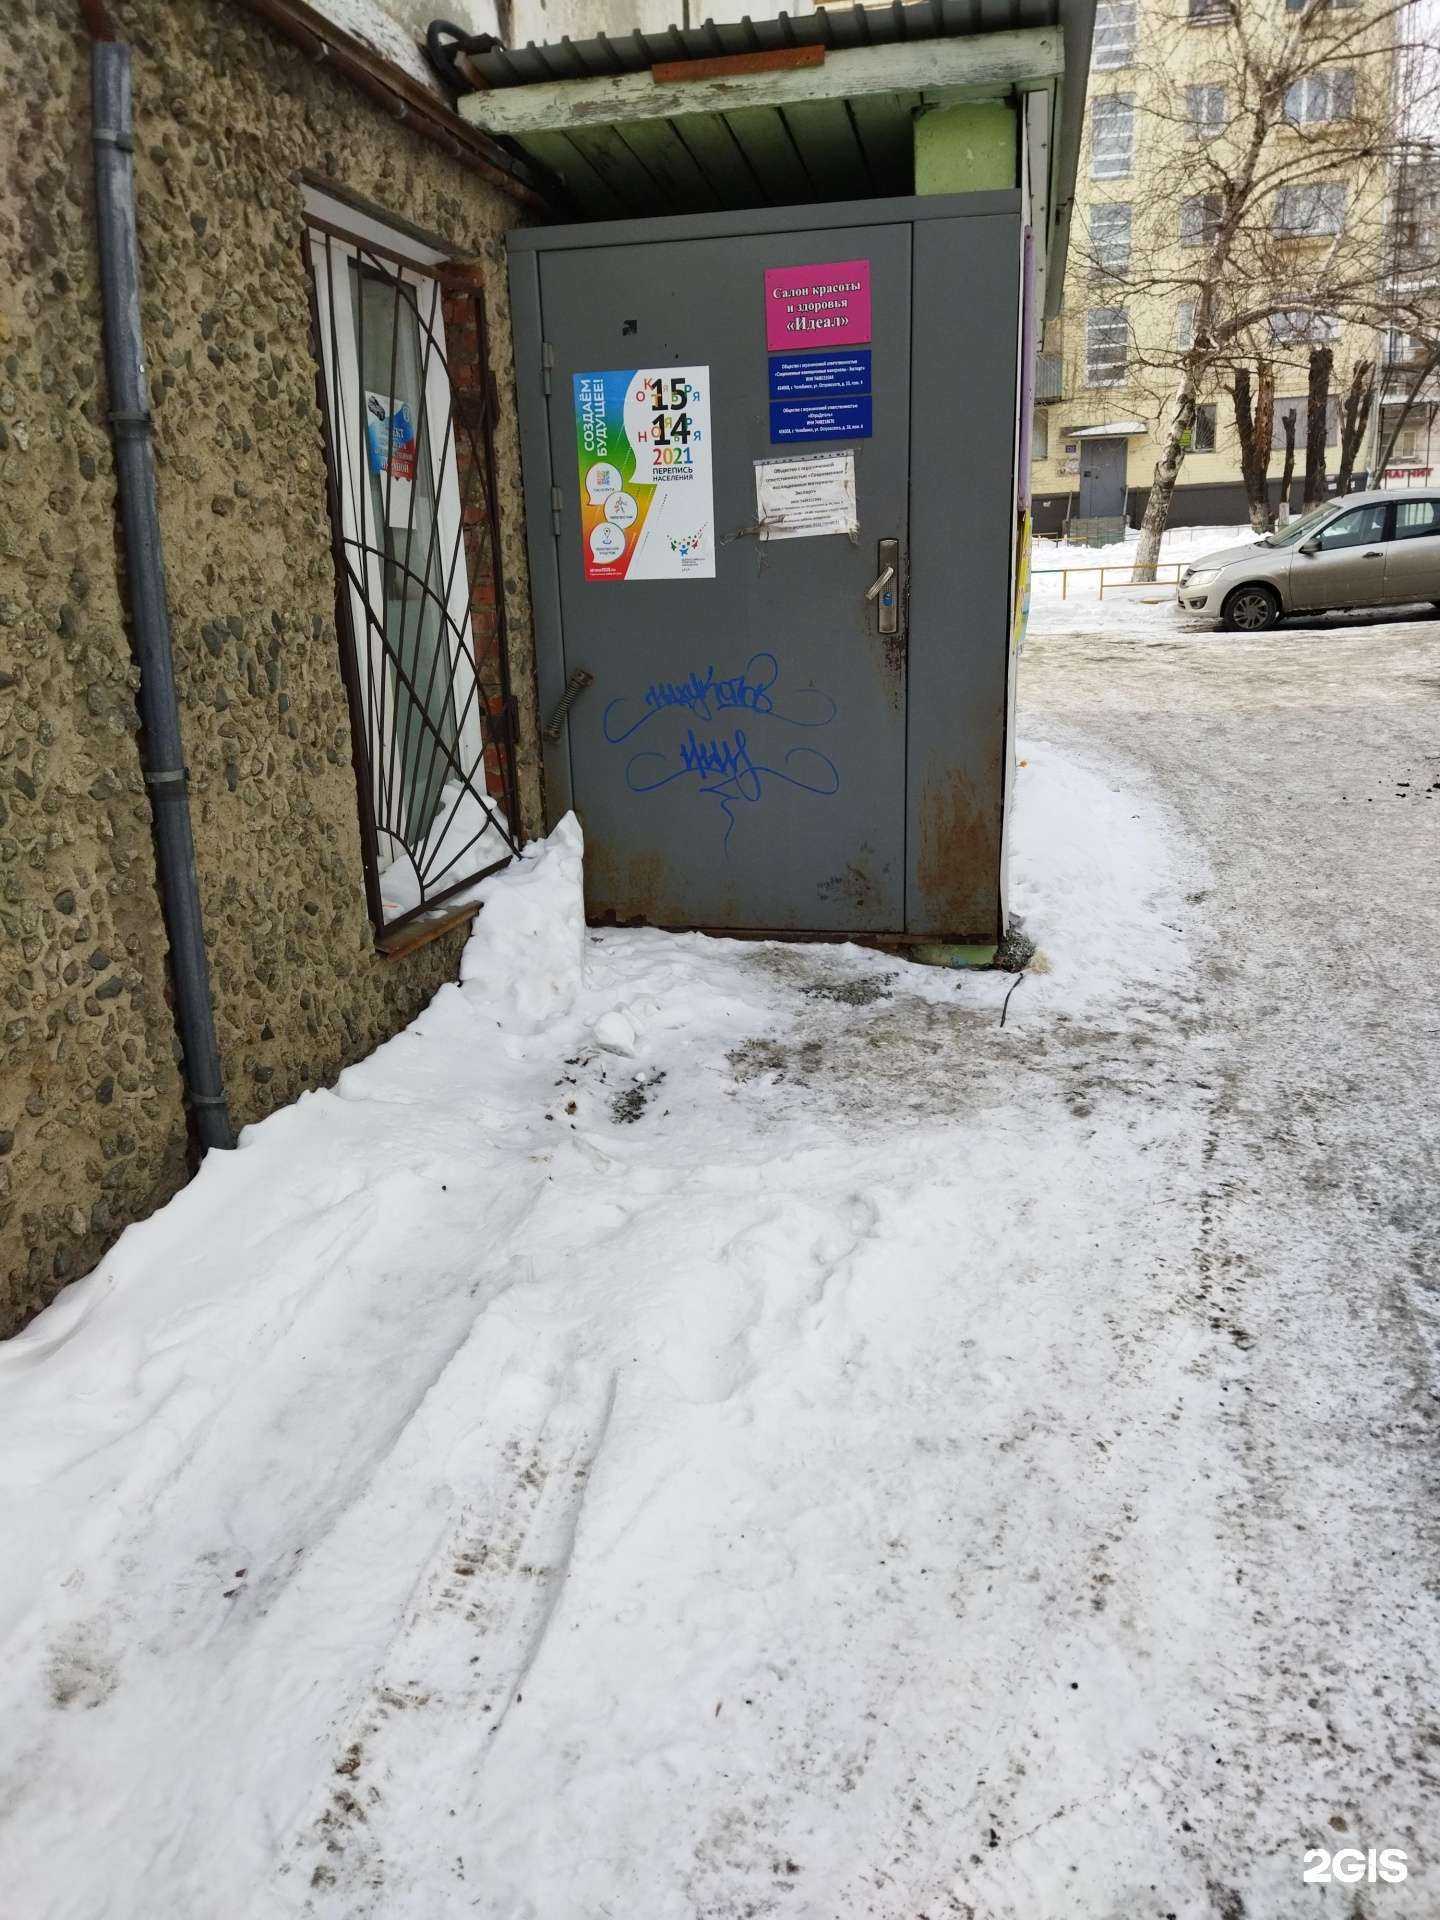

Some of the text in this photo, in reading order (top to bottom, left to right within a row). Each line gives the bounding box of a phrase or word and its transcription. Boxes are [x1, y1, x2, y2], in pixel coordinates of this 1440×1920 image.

[772, 282, 860, 298] Салон красоты
[787, 300, 848, 313] и здоровья
[787, 316, 849, 331] «Идеал»
[651, 377, 688, 411] 15
[580, 379, 595, 452] СОЗДАЁМ
[593, 378, 608, 456] БУДУЩЕЕ!
[652, 413, 691, 446] 14
[652, 447, 694, 466] 2021
[652, 467, 694, 475] ПЕРЕПИСЬ
[652, 474, 694, 482] НАСЕЛЕНИЯ
